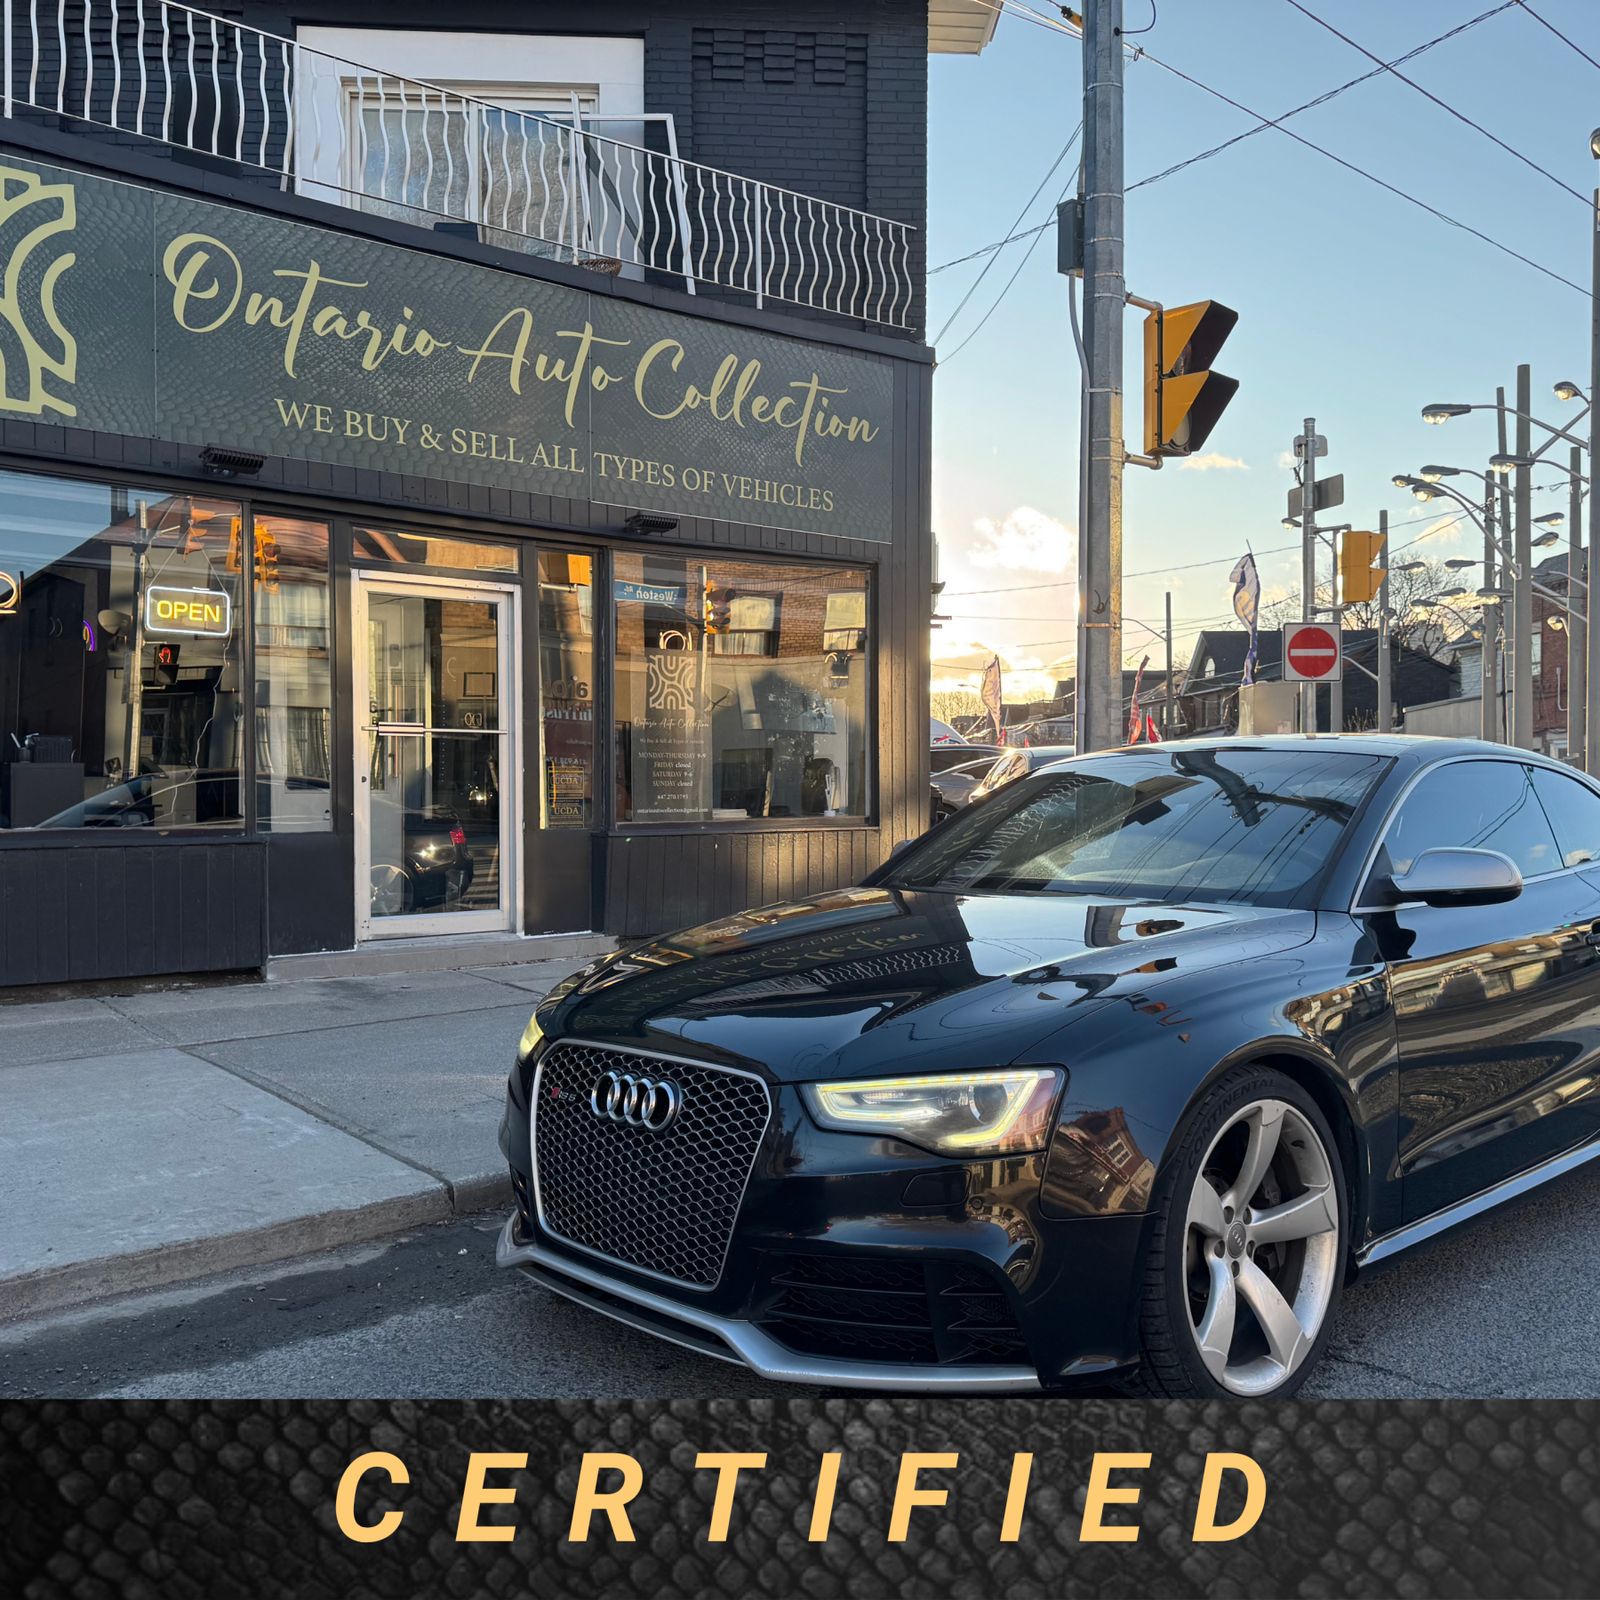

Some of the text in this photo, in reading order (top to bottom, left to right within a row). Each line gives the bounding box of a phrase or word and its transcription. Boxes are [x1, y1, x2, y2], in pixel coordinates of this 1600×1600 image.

[163, 233, 880, 467] Ontario Auto Collection
[274, 398, 834, 512] WE BUY & SELL ALL TYPES OF VEHICLES
[157, 600, 220, 622] OPEN
[543, 679, 588, 699] 1016
[553, 807, 579, 815] UCDA
[1188, 1079, 1276, 1170] CONTINENTAL
